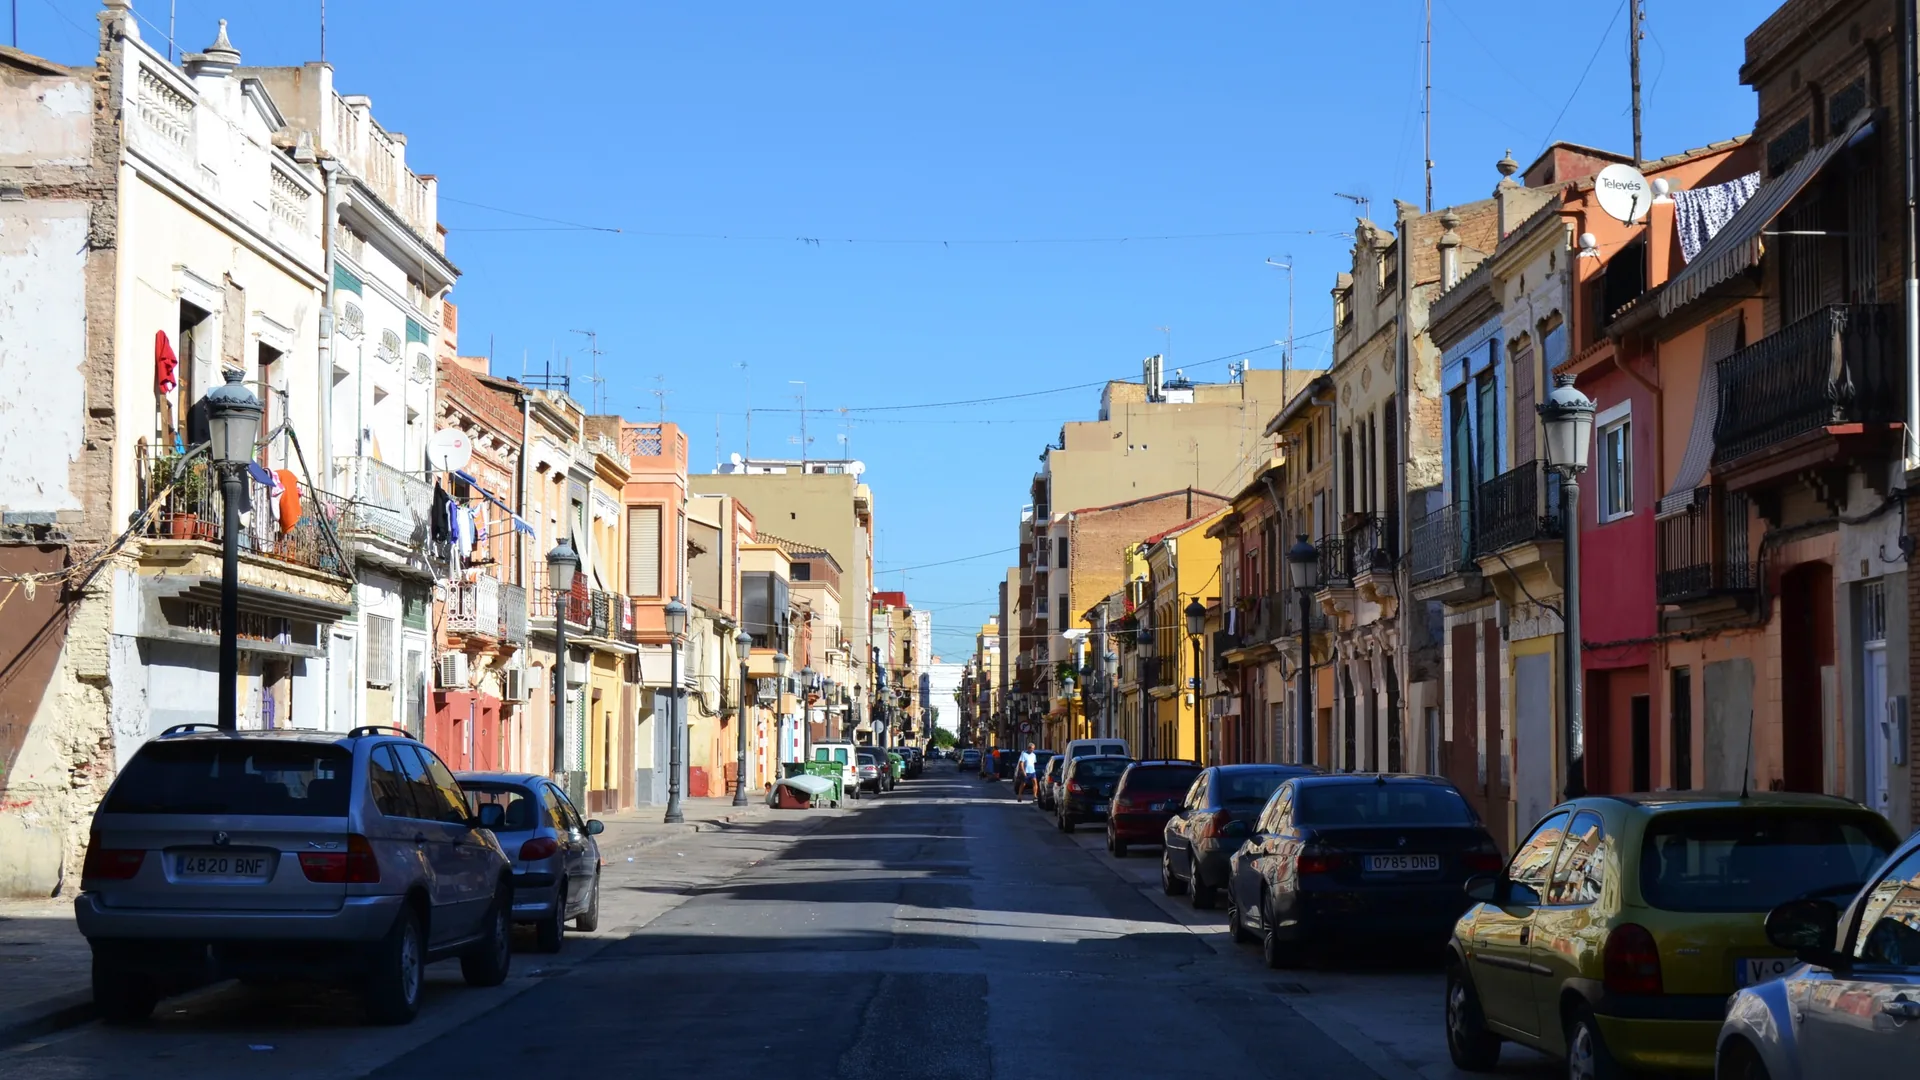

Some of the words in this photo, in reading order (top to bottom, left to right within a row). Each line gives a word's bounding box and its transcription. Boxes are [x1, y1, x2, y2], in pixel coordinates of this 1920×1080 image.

[1602, 177, 1641, 191] Televés
[186, 857, 228, 873] 4820
[235, 858, 265, 874] BNF
[1374, 856, 1407, 869] 0785
[1412, 856, 1437, 869] DNB
